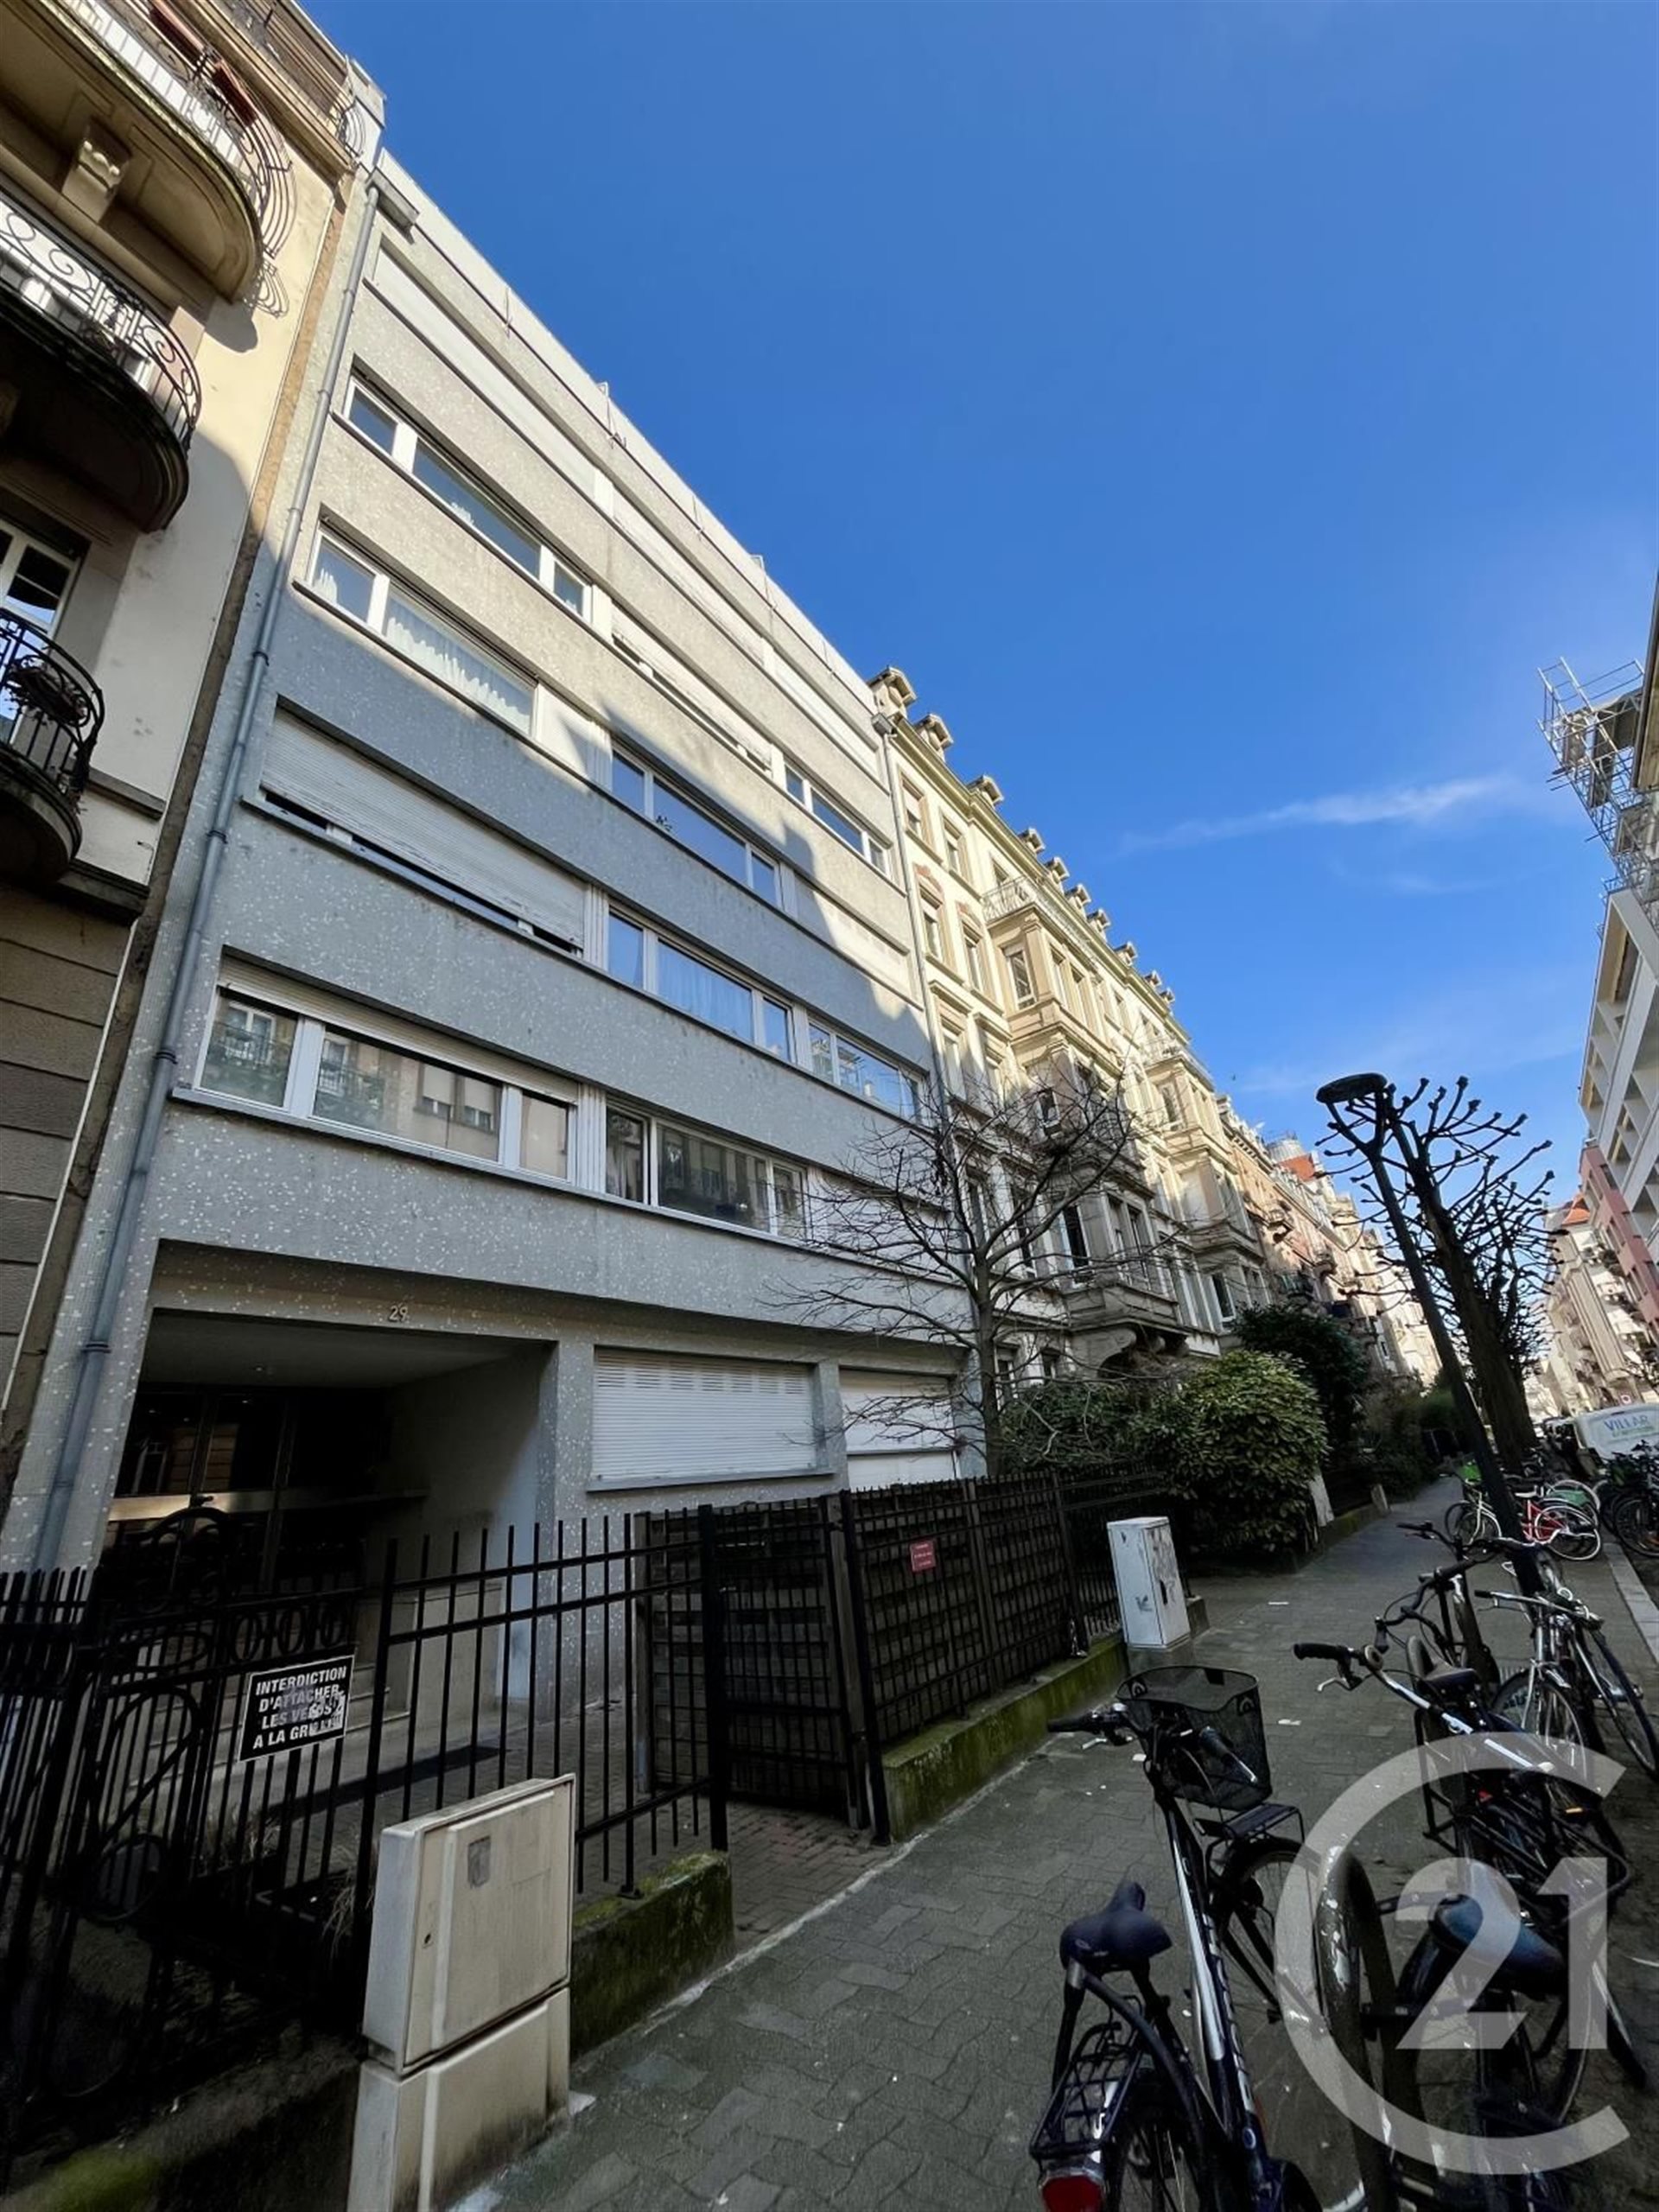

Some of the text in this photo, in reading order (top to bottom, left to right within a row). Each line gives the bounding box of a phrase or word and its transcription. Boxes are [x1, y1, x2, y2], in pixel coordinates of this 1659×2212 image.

[389, 1305, 408, 1321] 29
[256, 1666, 346, 1695] INTERDICTION
[259, 1684, 340, 1713] D'ATTACHER
[262, 1712, 288, 1729] LES
[252, 1735, 264, 1749] A
[268, 1730, 285, 1745] LA
